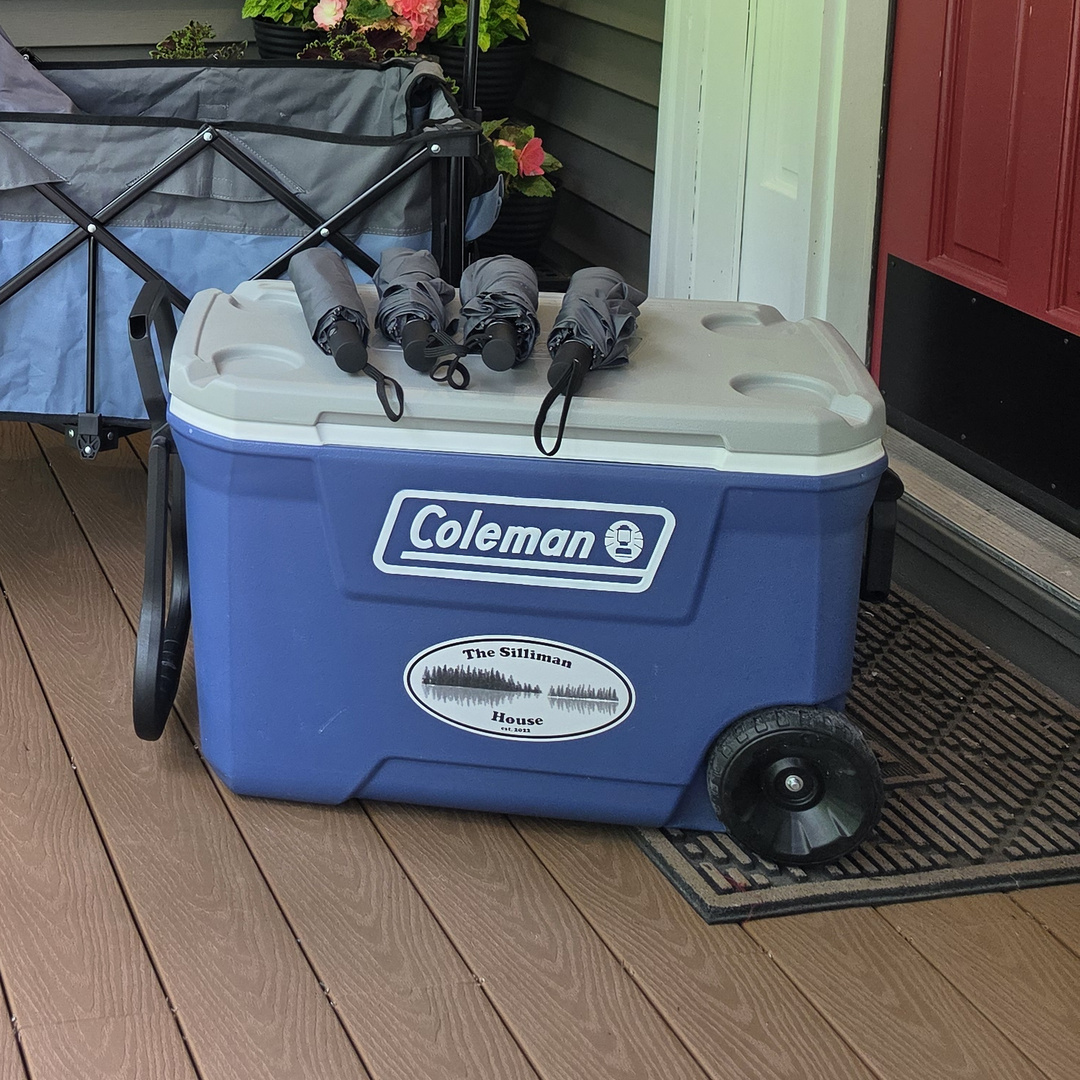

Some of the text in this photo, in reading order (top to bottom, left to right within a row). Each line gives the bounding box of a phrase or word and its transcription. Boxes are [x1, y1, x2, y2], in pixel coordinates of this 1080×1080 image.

[409, 504, 596, 560] Coleman
[462, 646, 573, 669] The Silliman
[490, 710, 544, 726] House
